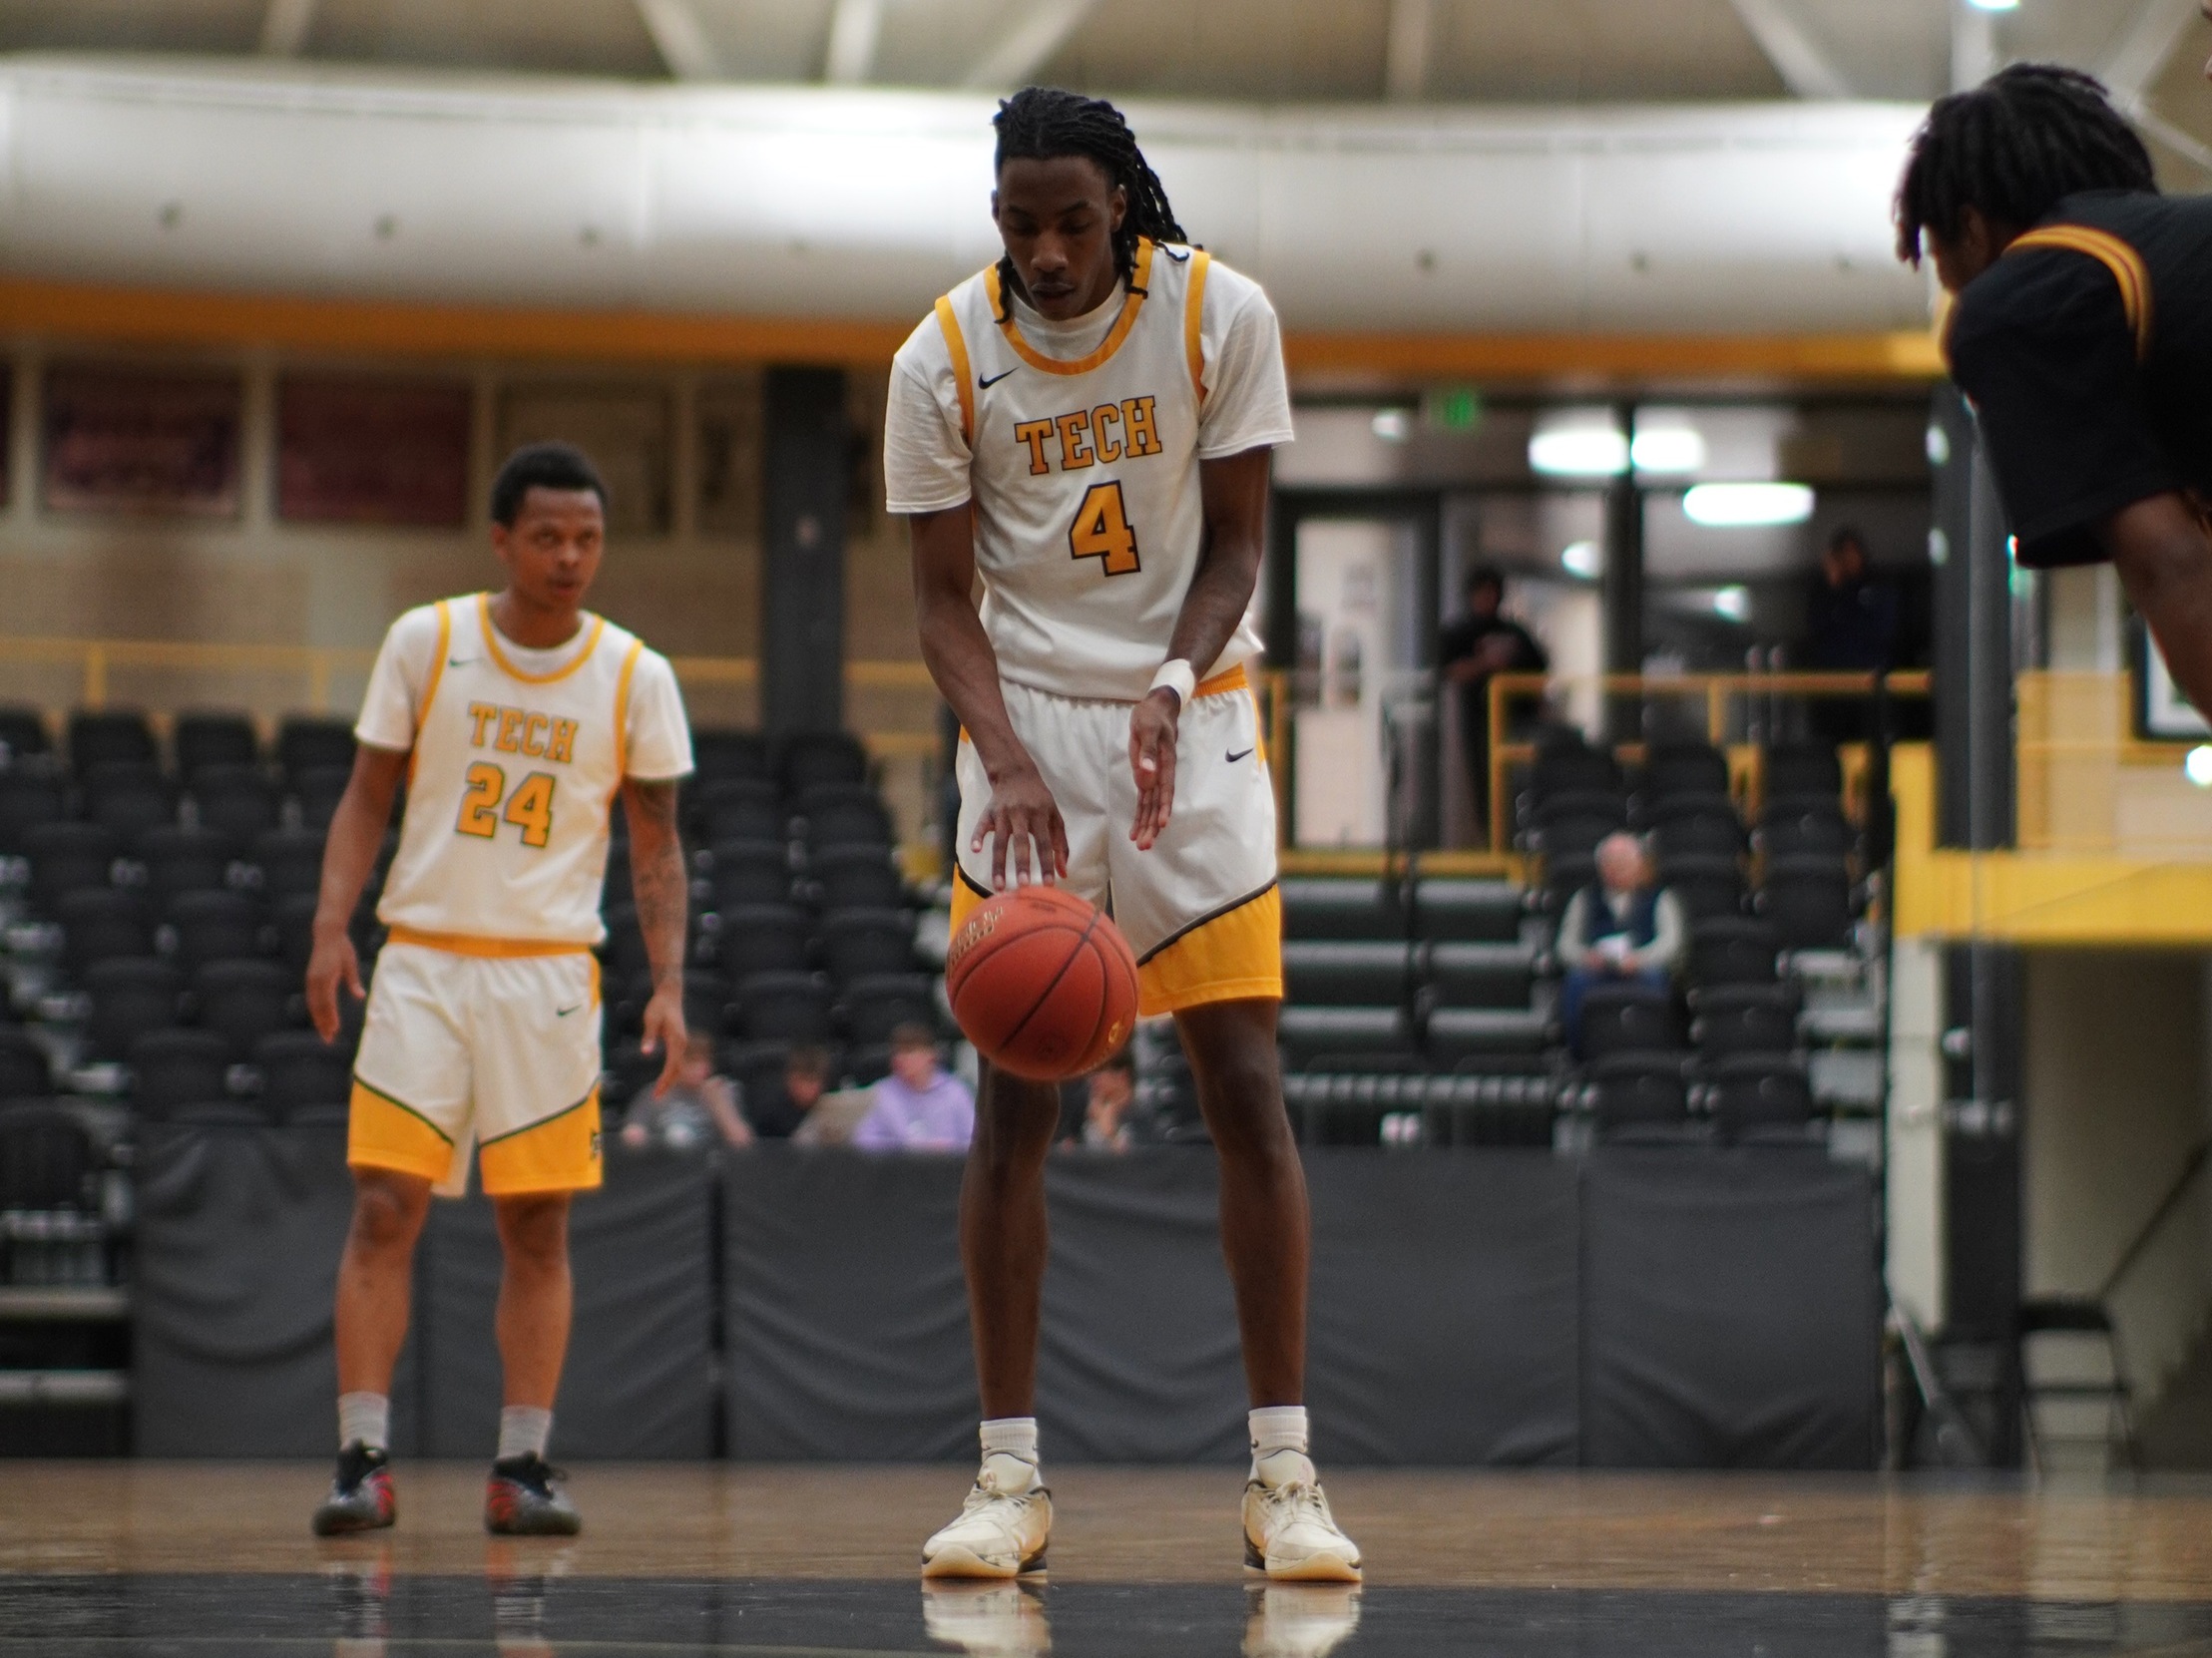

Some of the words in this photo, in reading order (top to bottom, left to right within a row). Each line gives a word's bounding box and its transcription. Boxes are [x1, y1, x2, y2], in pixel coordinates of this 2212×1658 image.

[1014, 395, 1162, 476] TECH
[1069, 480, 1141, 577] 4
[469, 701, 579, 764] TECH
[455, 761, 556, 848] 24
